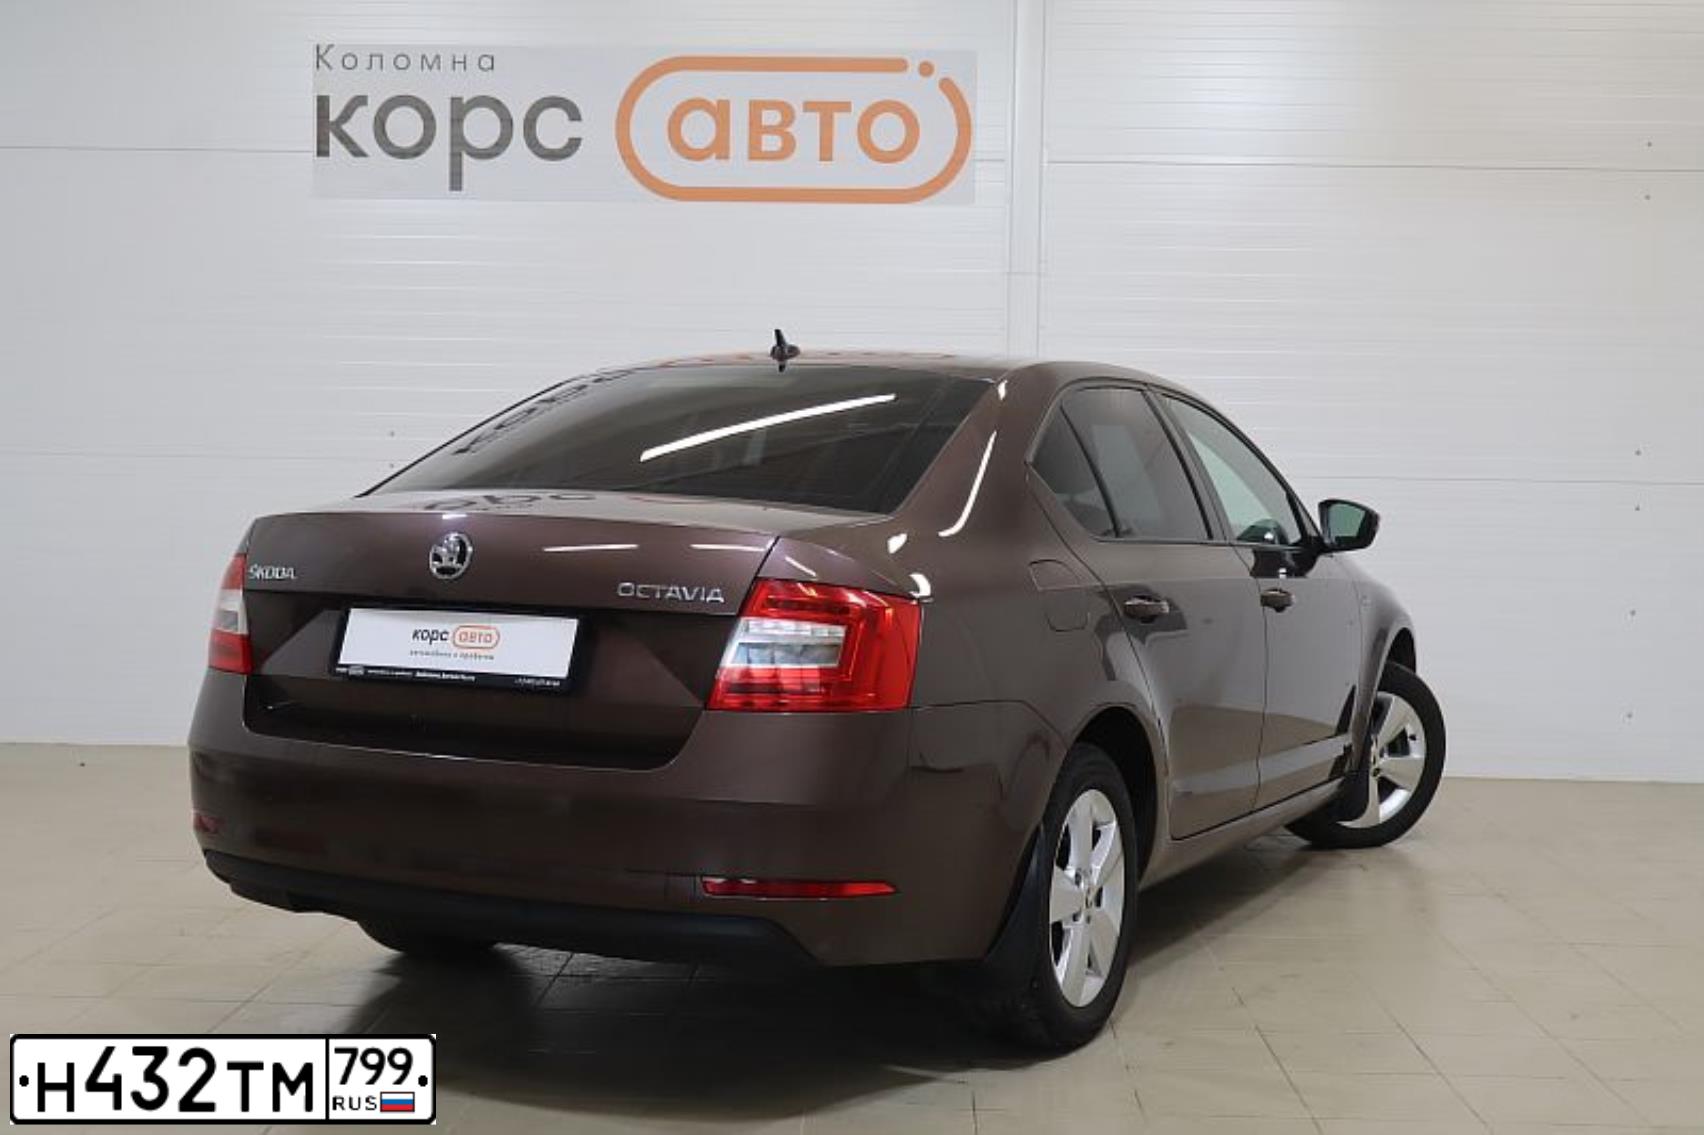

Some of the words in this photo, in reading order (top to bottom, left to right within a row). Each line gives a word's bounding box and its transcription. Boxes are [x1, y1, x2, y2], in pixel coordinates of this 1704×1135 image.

[315, 43, 495, 73] Коломна
[315, 94, 583, 192] корс
[667, 97, 921, 164] авто
[616, 581, 725, 603] OCTAVIA
[412, 628, 450, 645] корс
